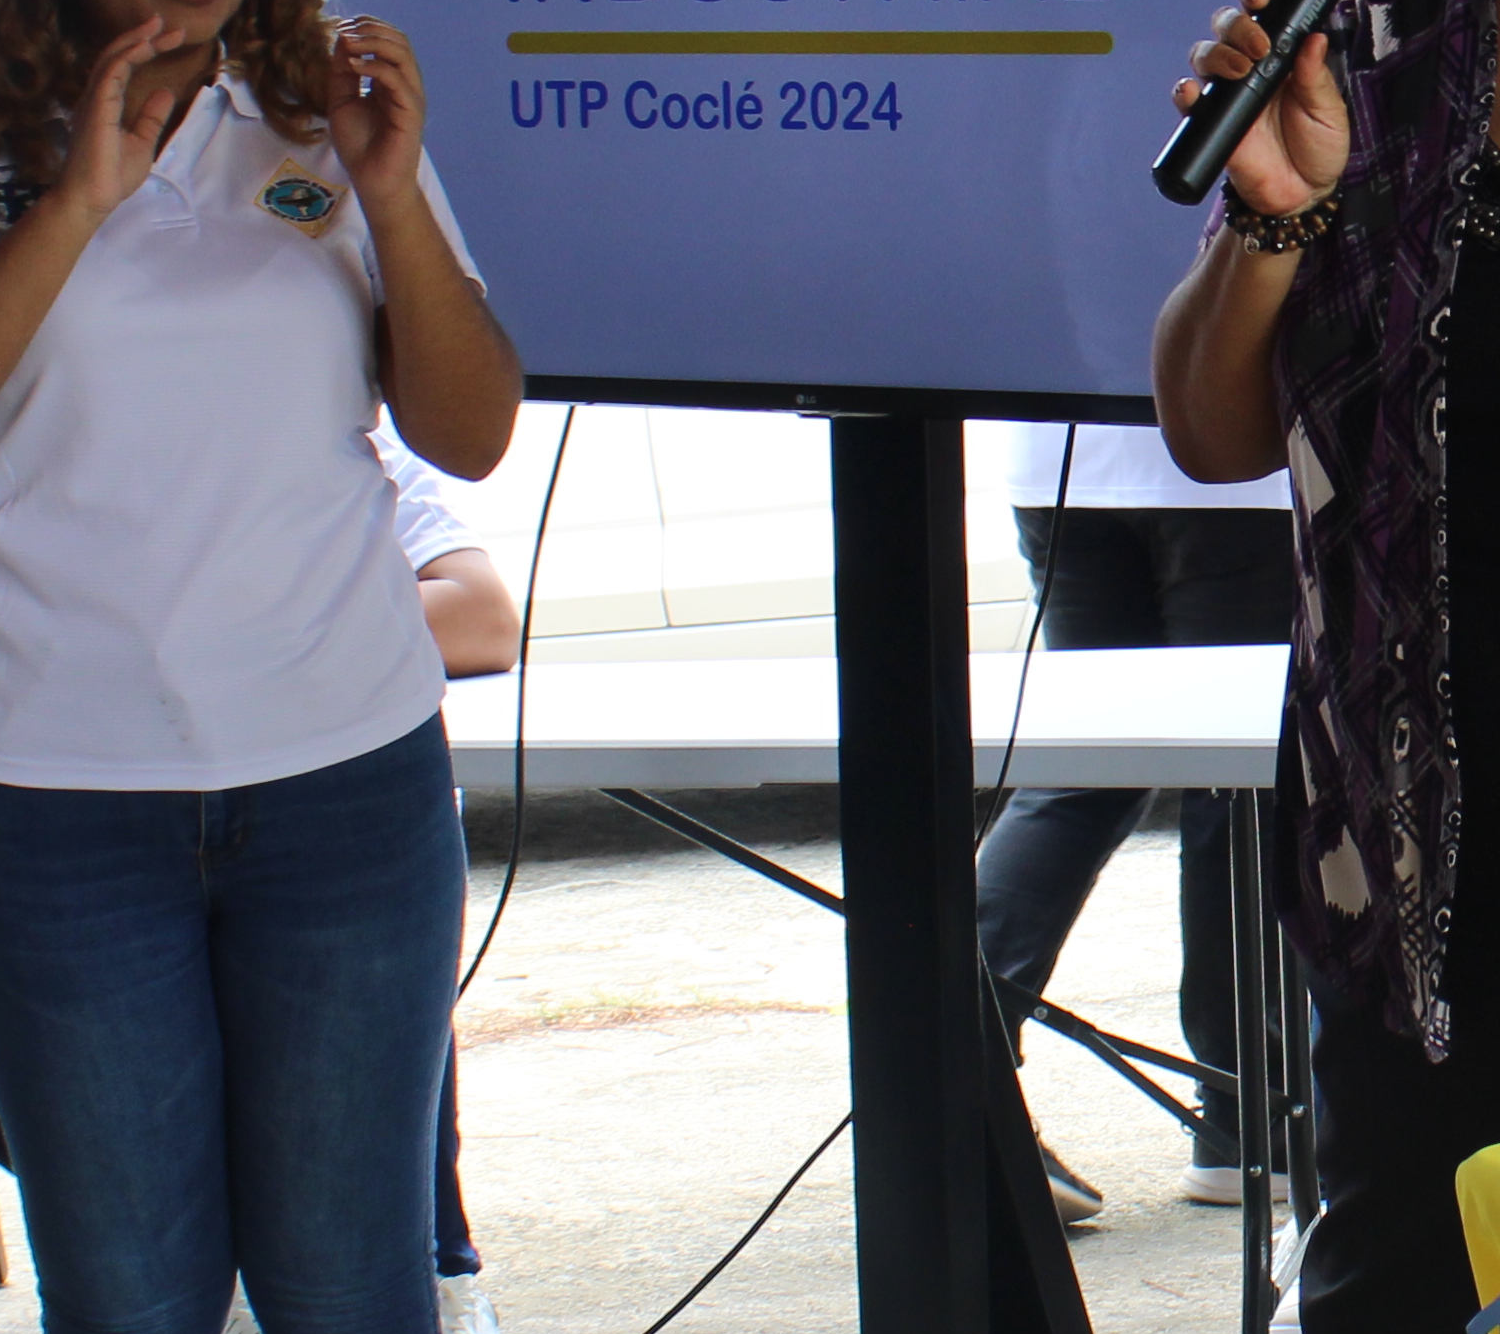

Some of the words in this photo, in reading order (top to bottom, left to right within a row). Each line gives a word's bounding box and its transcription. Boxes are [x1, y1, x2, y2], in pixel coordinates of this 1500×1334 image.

[510, 80, 607, 129] UTP
[624, 80, 763, 130] Coclé
[779, 80, 903, 131] 2024
